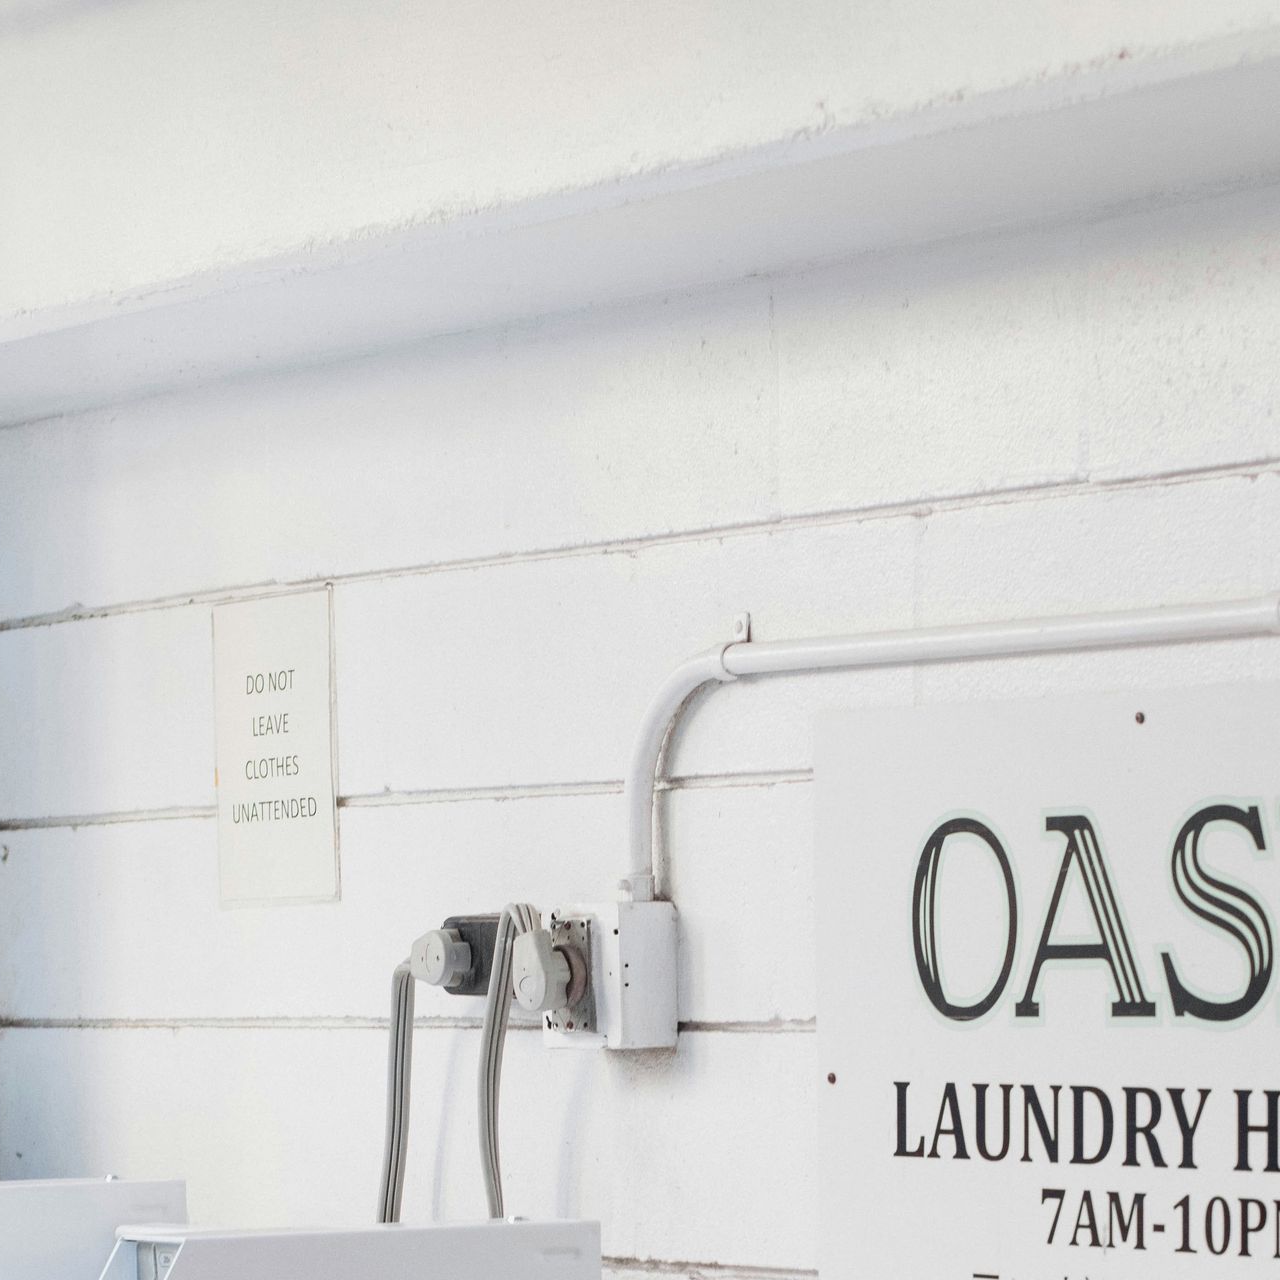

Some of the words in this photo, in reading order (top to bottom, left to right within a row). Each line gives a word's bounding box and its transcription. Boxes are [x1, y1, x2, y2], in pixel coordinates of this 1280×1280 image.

[246, 673, 265, 695] DO
[268, 669, 295, 692] NOT
[252, 712, 289, 737] LEAVE
[245, 754, 299, 780] CLOTHES
[232, 796, 317, 824] UNATTENDED
[893, 1081, 1212, 1170] LAUNDRY
